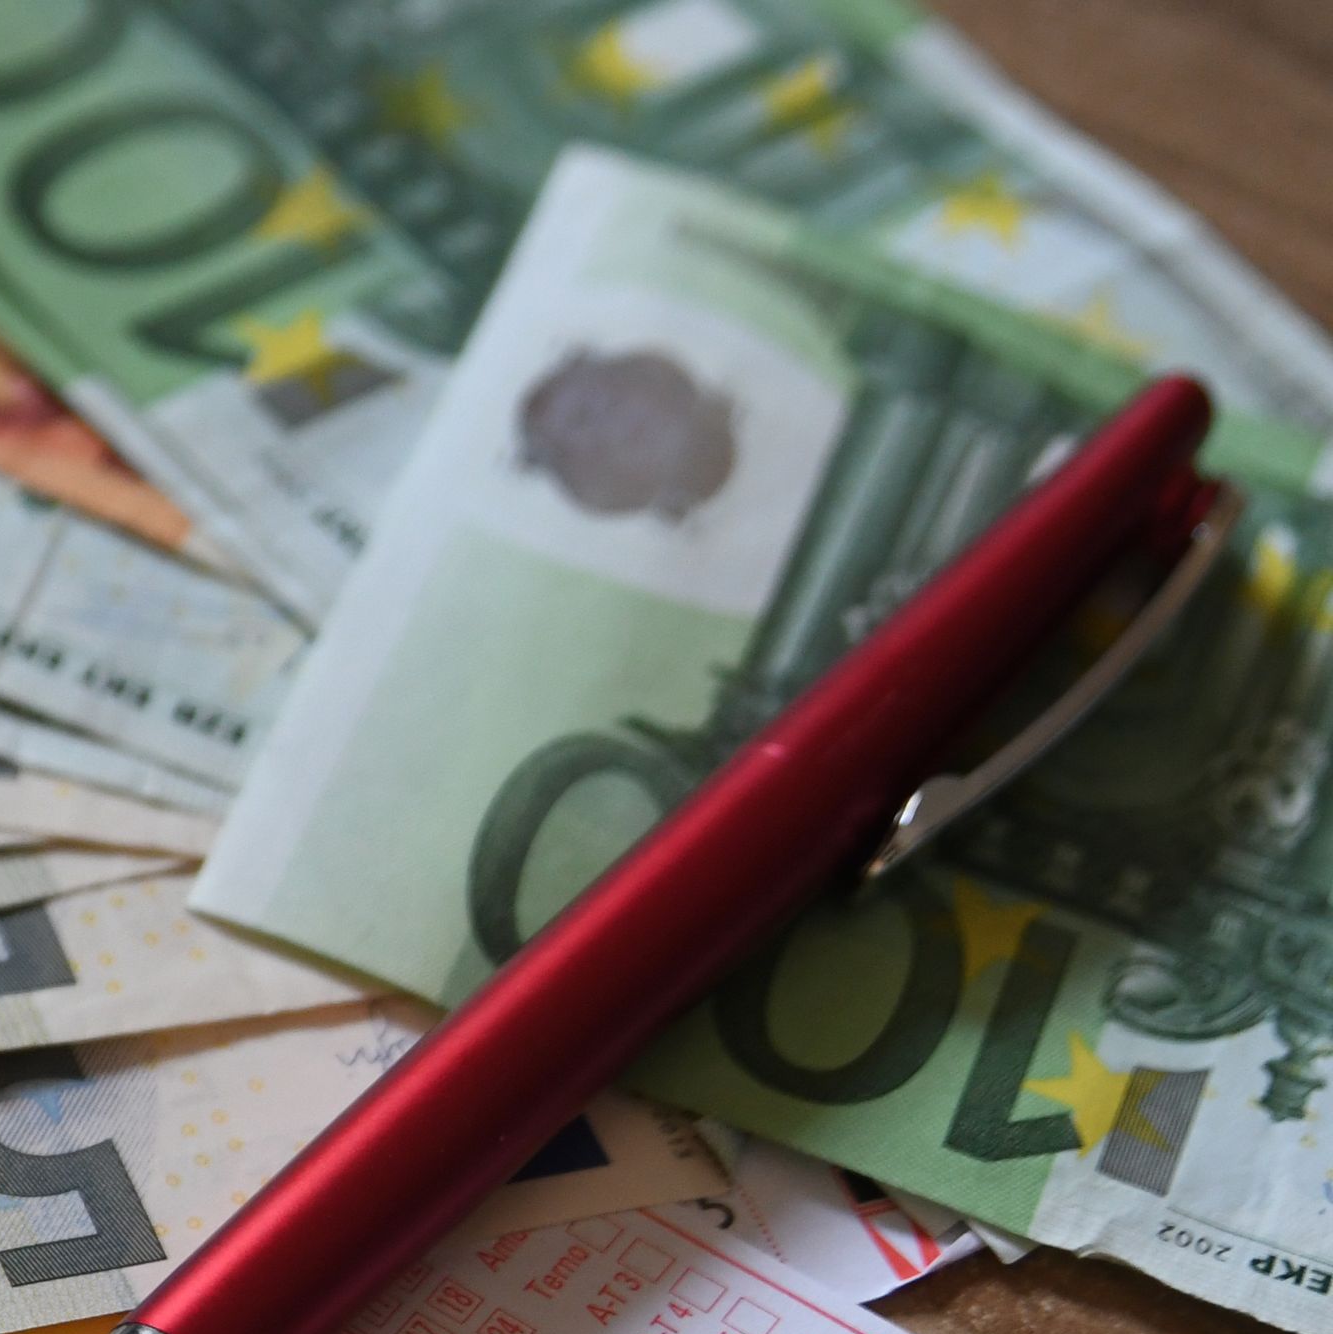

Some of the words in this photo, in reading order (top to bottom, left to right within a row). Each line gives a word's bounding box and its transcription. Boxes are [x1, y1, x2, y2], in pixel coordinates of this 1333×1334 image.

[1155, 1220, 1235, 1262] 2002
[523, 1245, 590, 1300] Terno
[1249, 1254, 1332, 1296] EKP
[586, 1283, 626, 1326] A-T
[624, 1271, 643, 1292] 3
[672, 1301, 694, 1321] 4
